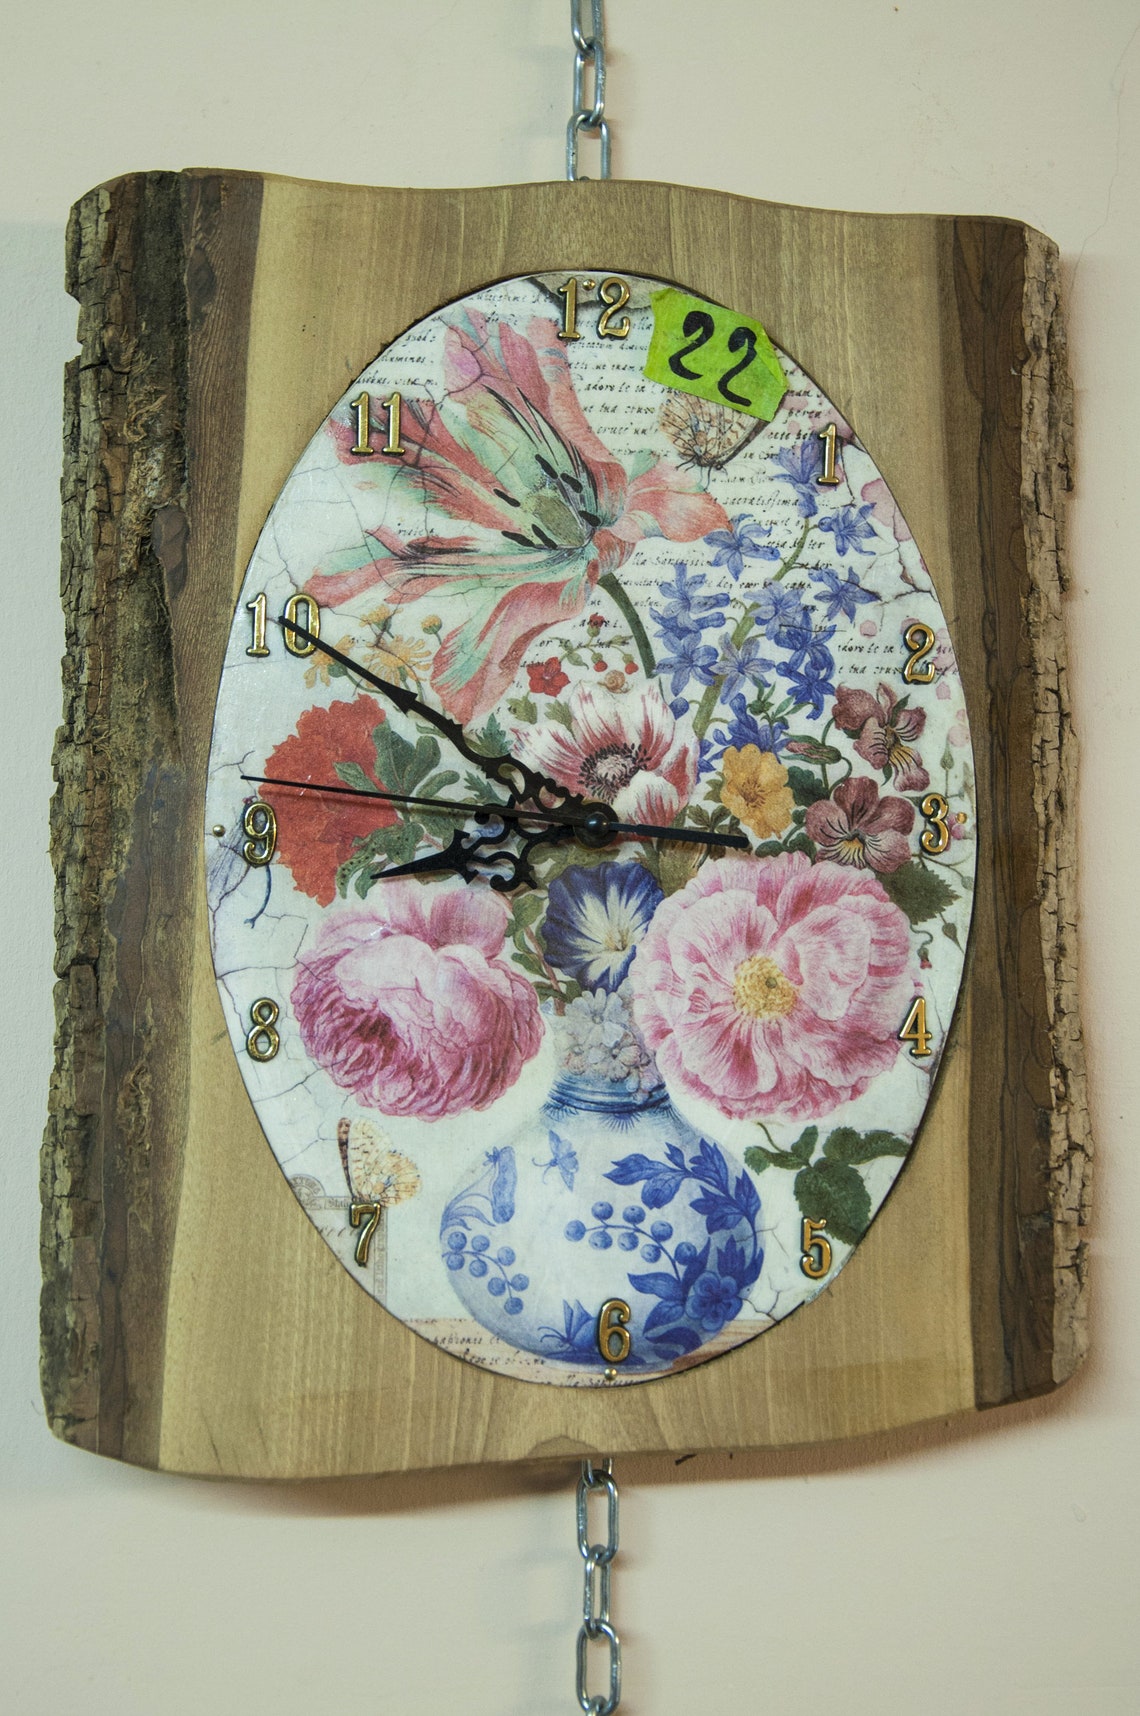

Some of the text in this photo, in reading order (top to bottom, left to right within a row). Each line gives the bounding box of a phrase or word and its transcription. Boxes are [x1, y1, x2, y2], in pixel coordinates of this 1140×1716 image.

[558, 277, 631, 339] 12
[668, 310, 757, 407] 22
[351, 391, 405, 455] 11
[816, 422, 840, 485] 1
[246, 594, 320, 657] 10
[904, 622, 935, 684] 2
[242, 802, 277, 867] 9
[919, 793, 949, 855] 3
[245, 997, 281, 1063] 8
[899, 997, 932, 1057] 4
[350, 1202, 381, 1267] 7
[799, 1217, 832, 1280] 5
[598, 1298, 631, 1363] 6
